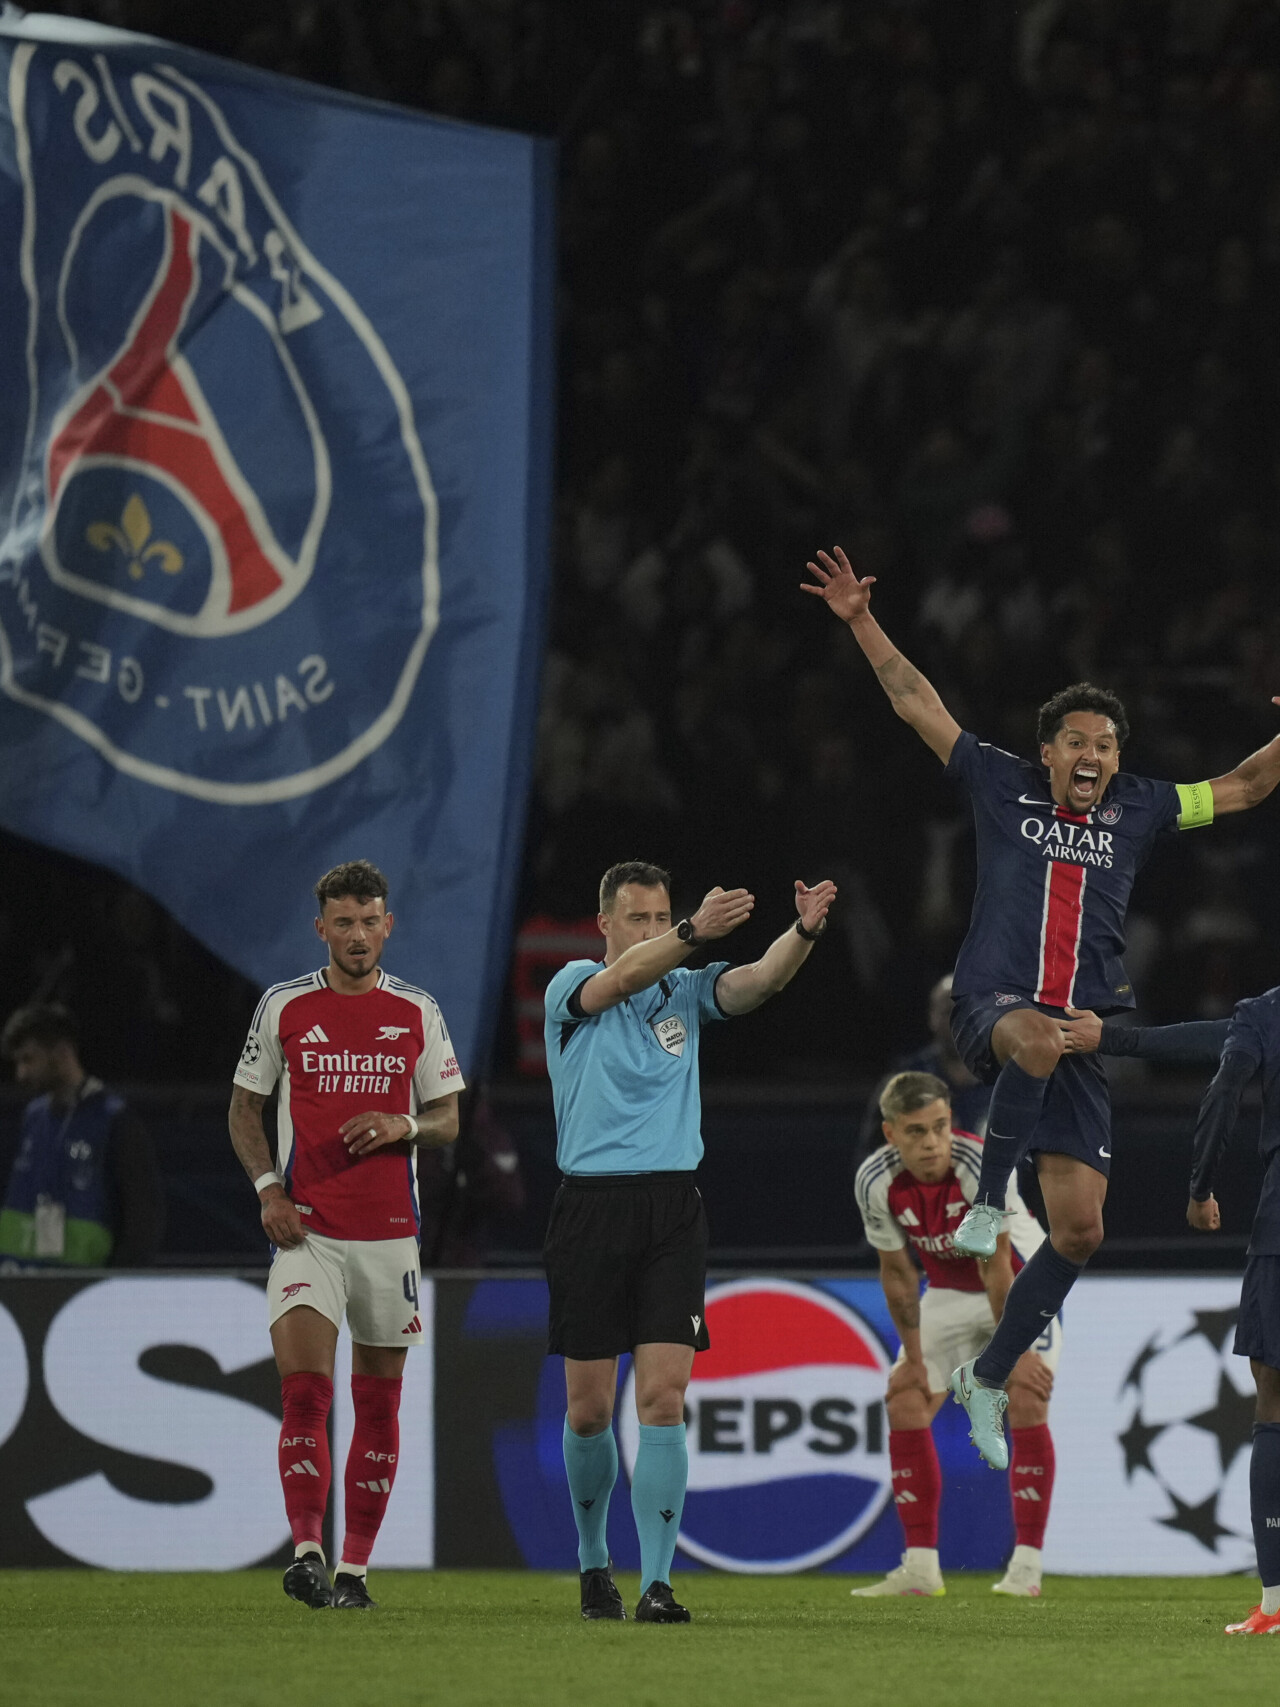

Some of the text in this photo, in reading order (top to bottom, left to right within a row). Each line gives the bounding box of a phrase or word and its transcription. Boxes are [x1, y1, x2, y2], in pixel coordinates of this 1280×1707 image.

[1020, 817, 1115, 854] QATAR
[1042, 843, 1114, 869] AIRWAYS
[661, 1021, 679, 1034] UEFA
[665, 1032, 683, 1043] MATCH
[300, 1049, 406, 1074] Emirates
[317, 1075, 391, 1094] FLY BETTER
[402, 1269, 420, 1312] 4
[0, 1276, 434, 1572] SI
[281, 1436, 317, 1449] AFC
[364, 1450, 397, 1464] AFC
